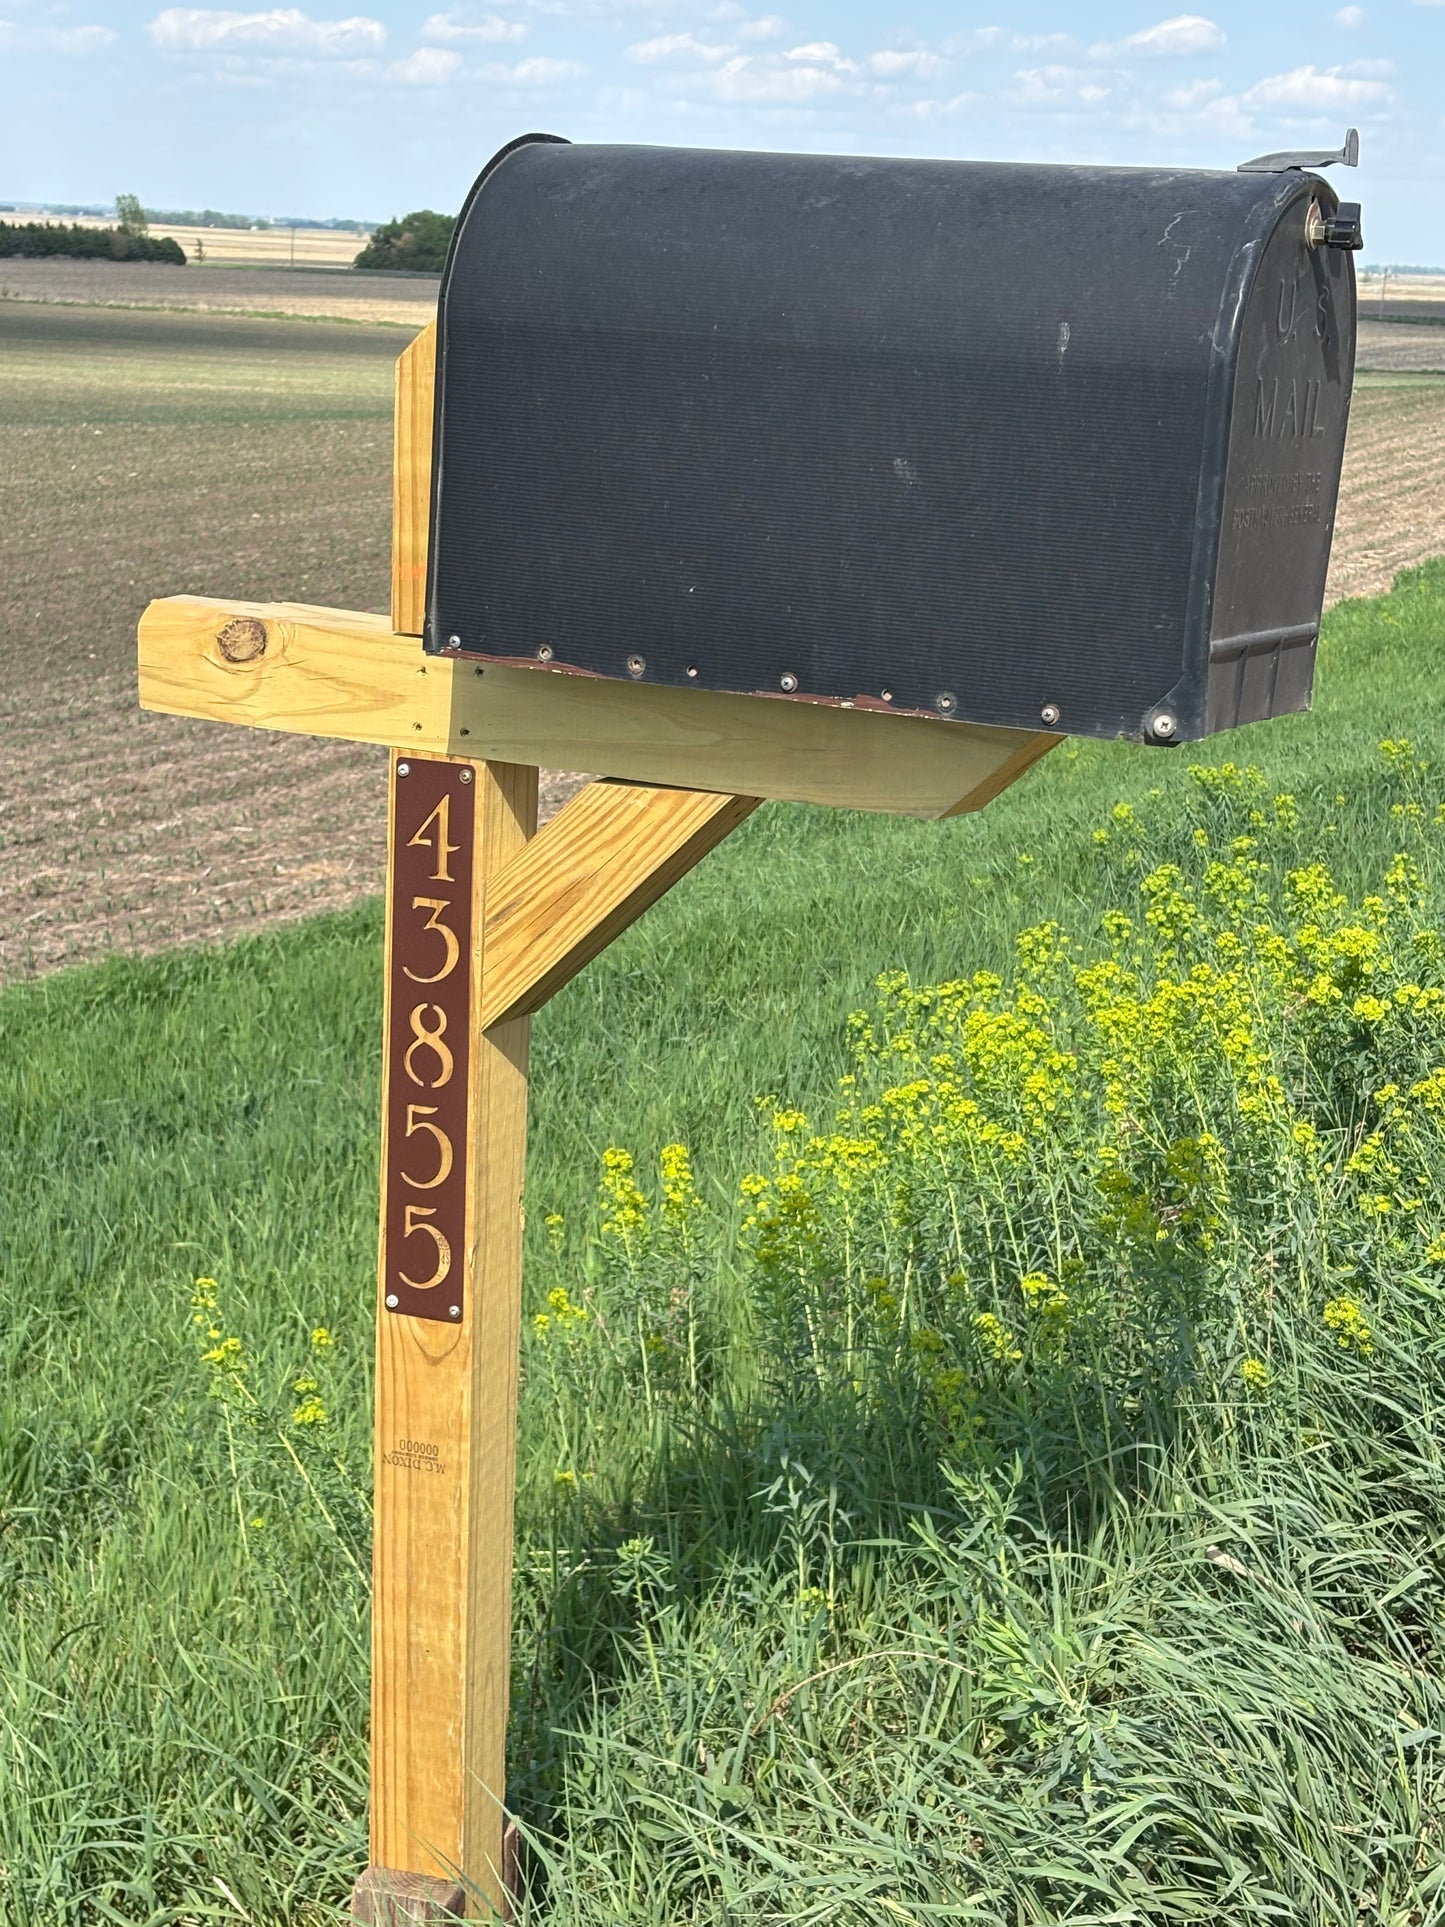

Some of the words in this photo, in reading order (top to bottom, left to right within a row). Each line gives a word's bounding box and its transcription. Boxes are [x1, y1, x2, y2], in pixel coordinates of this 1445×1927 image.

[1253, 376, 1326, 438] MAIL
[400, 793, 461, 1290] 43855
[381, 1453, 421, 1470] DIXON
[399, 1439, 438, 1456] 000000
